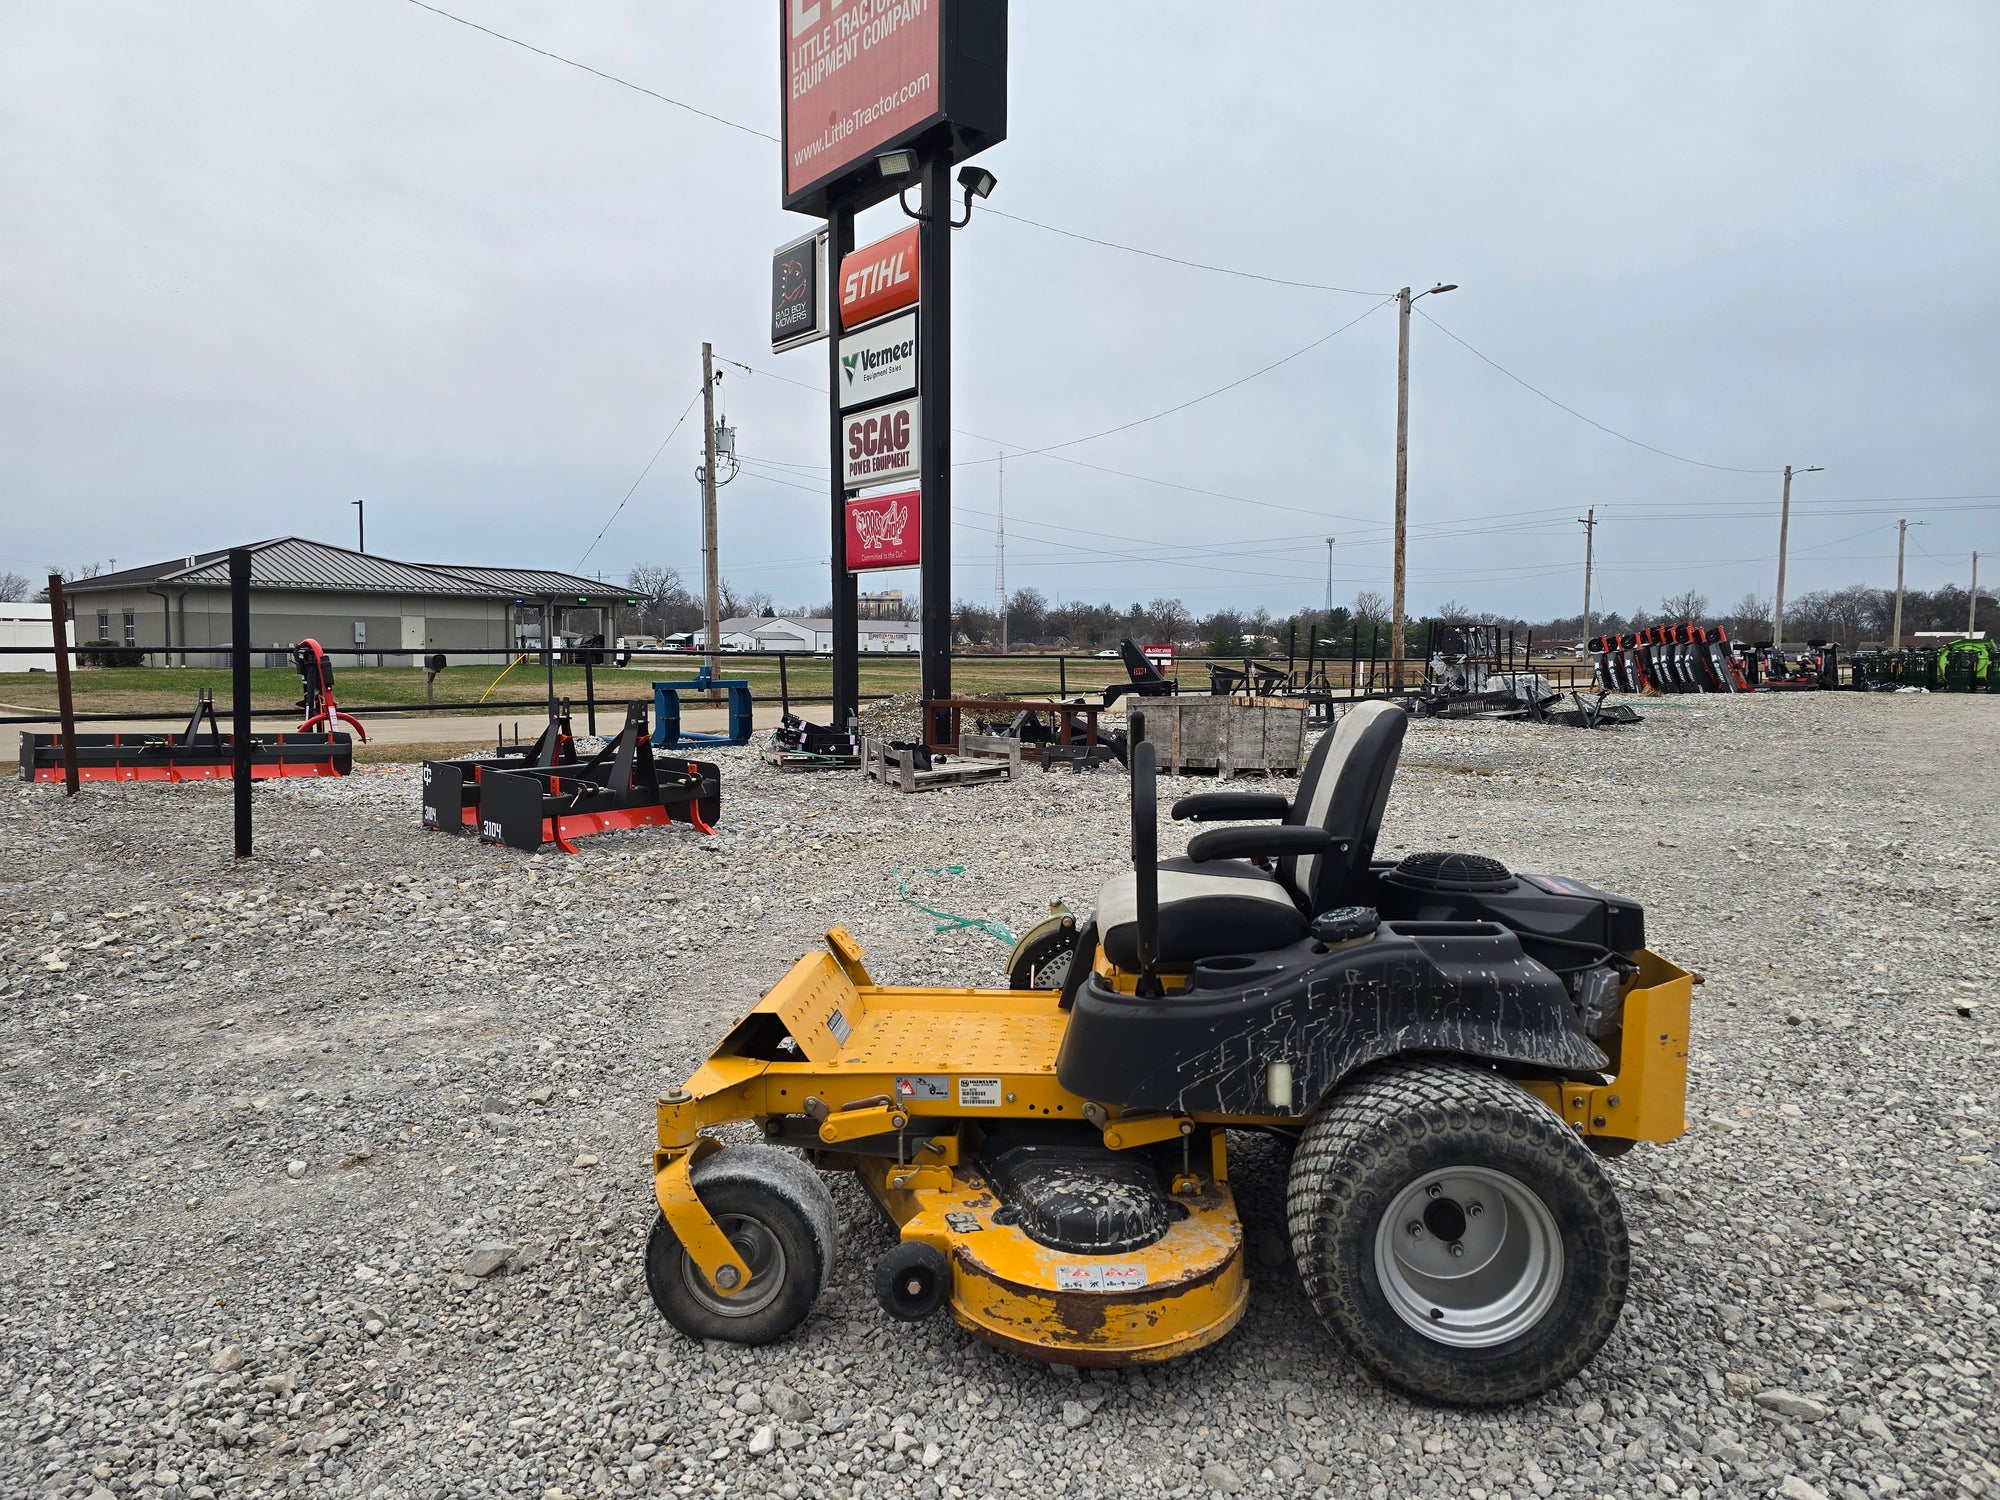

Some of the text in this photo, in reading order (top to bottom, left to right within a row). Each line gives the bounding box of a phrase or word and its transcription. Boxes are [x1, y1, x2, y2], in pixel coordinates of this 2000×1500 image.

[792, 25, 831, 75] LITTLE
[833, 0, 896, 43] TRACTO
[792, 32, 860, 100] EQUIPMENT
[794, 72, 931, 166] www.LittleTractor.com
[843, 249, 910, 306] STIHL
[775, 301, 807, 321] BAD BOY
[775, 310, 807, 329] MOWERS
[860, 339, 914, 371] Vermeer
[863, 364, 902, 382] Equipment Sales
[848, 409, 910, 460] SCAG
[849, 450, 910, 477] POWER EQUIPMENT
[483, 820, 502, 839] 3104
